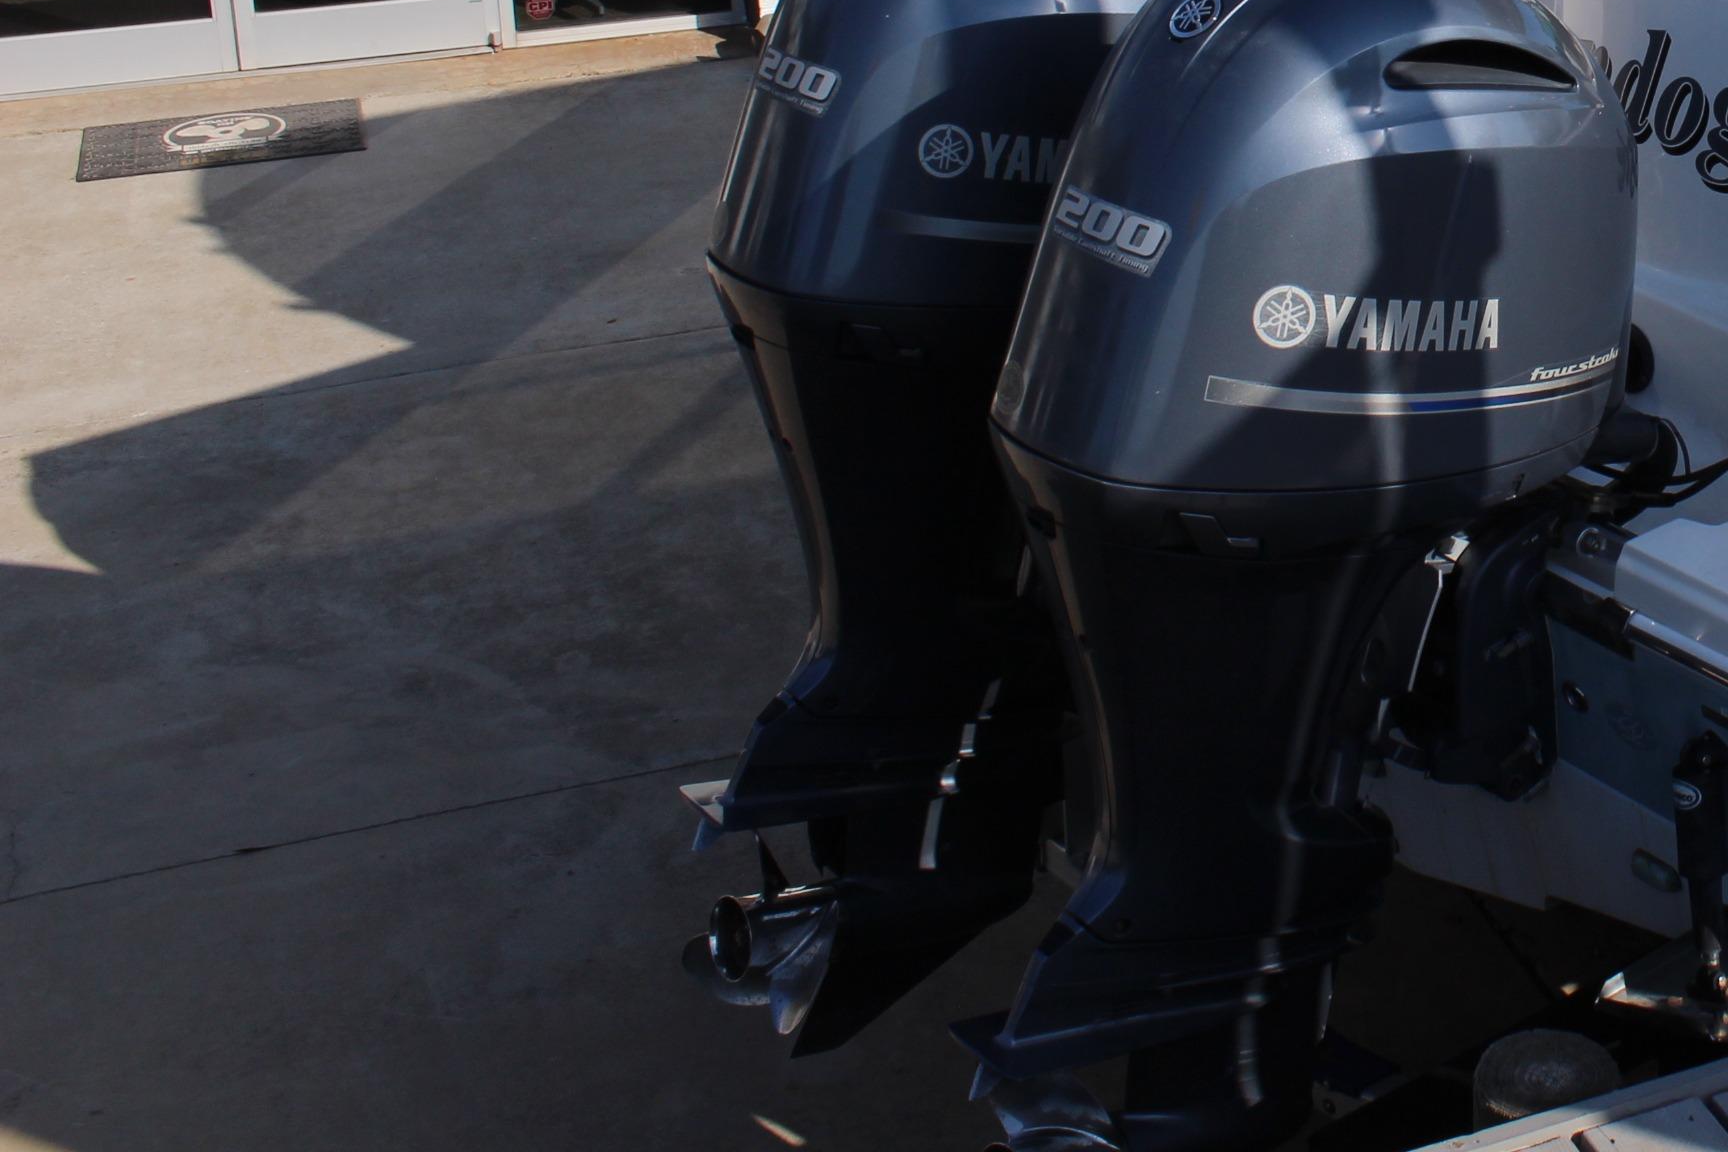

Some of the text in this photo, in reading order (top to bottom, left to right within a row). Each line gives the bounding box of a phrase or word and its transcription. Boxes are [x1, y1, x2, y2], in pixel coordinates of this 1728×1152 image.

[759, 47, 837, 102] 200
[980, 131, 1068, 184] YAM
[1056, 185, 1166, 258] 200
[1323, 293, 1500, 352] YAMAHA
[1530, 346, 1619, 382] fourstrok
